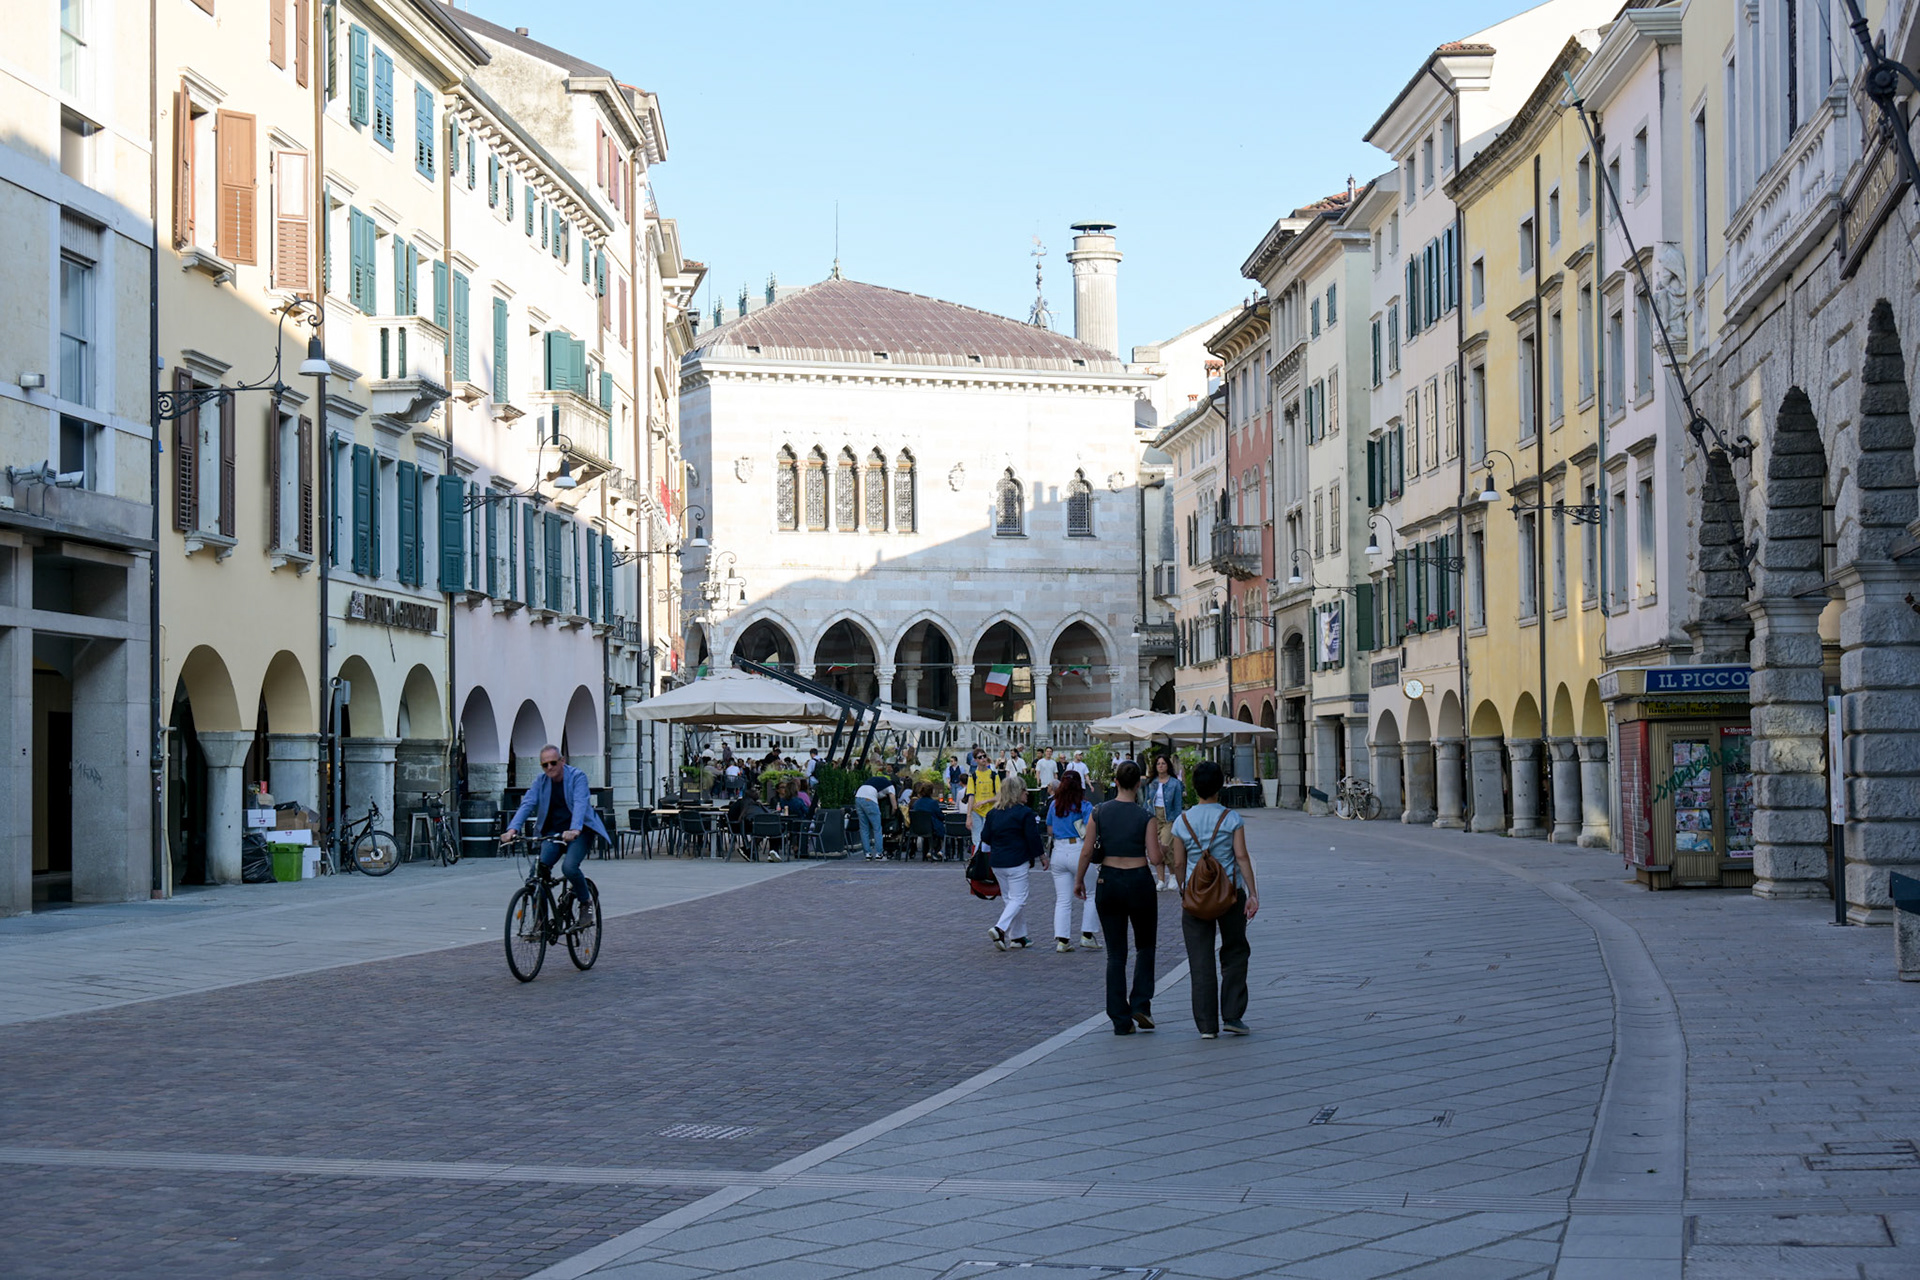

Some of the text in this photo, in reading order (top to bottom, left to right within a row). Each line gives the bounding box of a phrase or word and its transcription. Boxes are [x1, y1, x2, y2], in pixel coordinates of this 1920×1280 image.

[365, 594, 438, 631] BANCA GENERALI
[1658, 673, 1677, 688] IL
